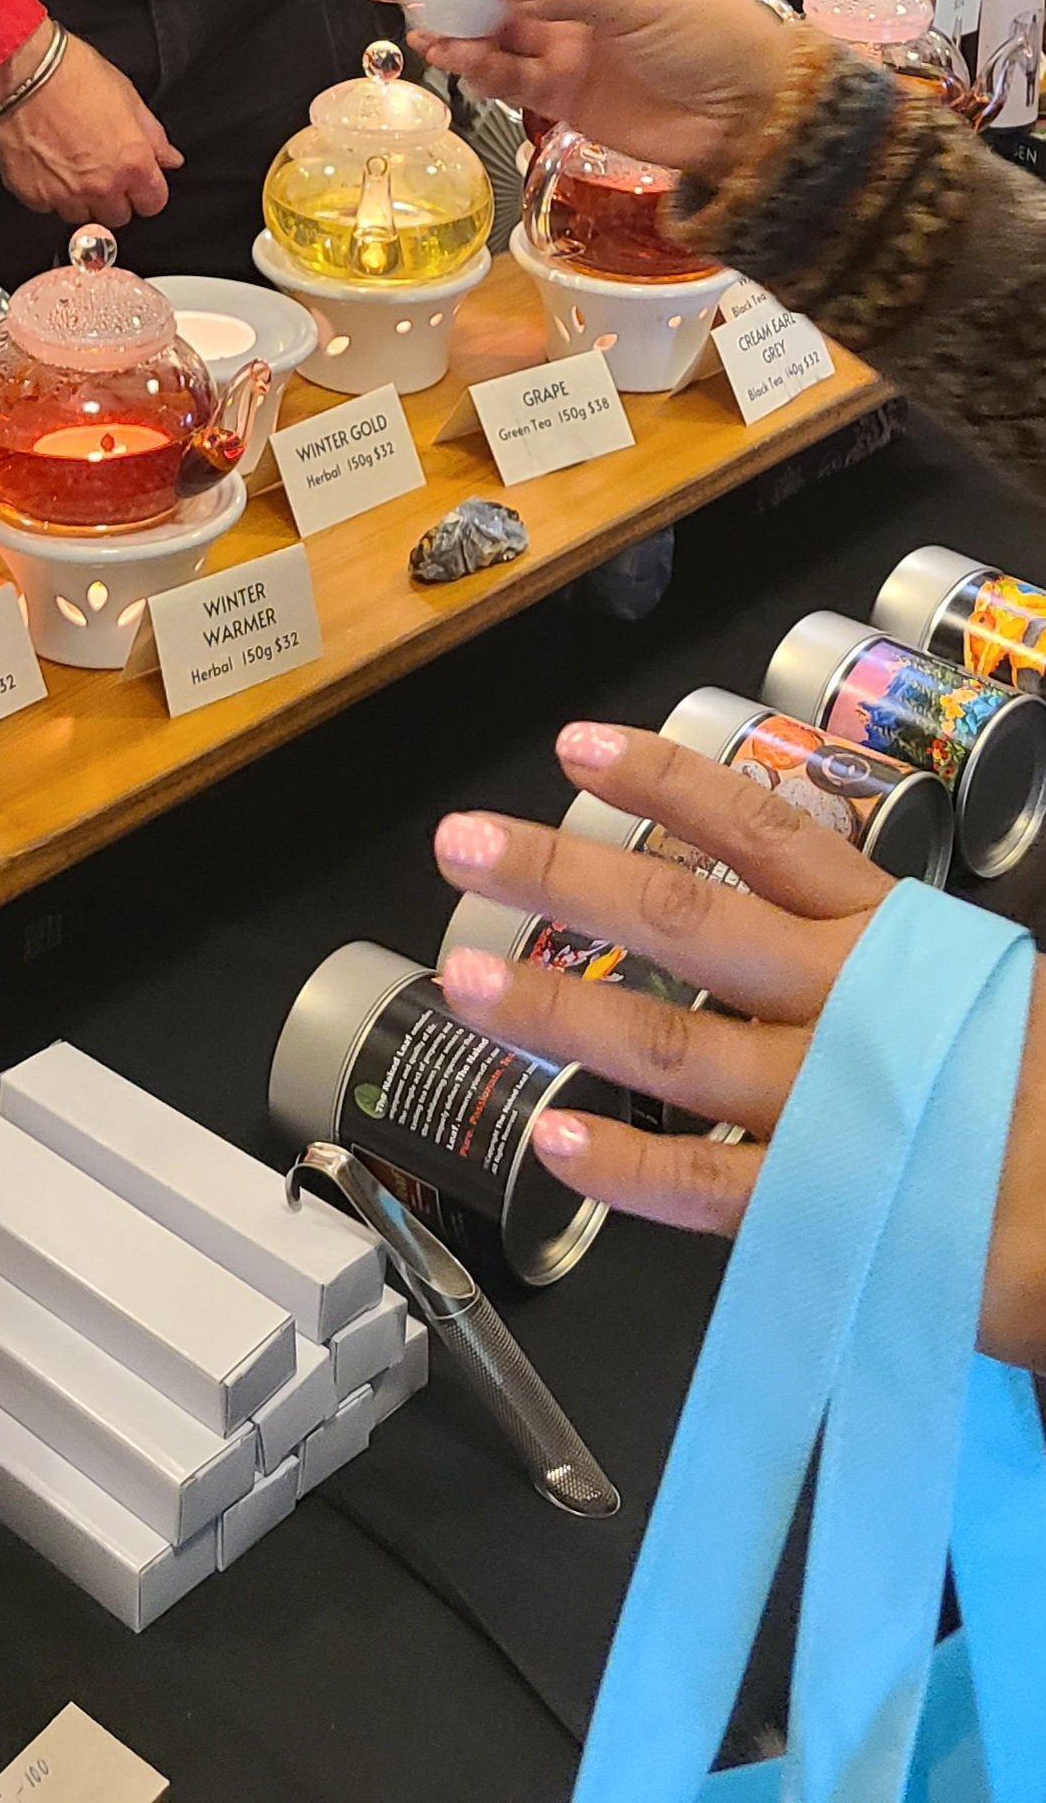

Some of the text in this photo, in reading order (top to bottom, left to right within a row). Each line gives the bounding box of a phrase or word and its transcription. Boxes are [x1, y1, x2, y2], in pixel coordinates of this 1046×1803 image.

[752, 292, 767, 307] Tea
[738, 311, 796, 351] CREAM EARL
[762, 340, 786, 364] GREY
[522, 381, 569, 407] GRAPE
[747, 383, 768, 401] Black
[768, 375, 783, 390] Tea
[804, 351, 820, 369] $32
[295, 414, 387, 463] WINTER GOLD
[498, 397, 610, 441] Green Tea 150g $38
[306, 441, 395, 489] Herbal 150g $32
[203, 582, 266, 618] WINTER
[203, 607, 277, 648] WARMER
[191, 632, 299, 685] Herbal 150g $32
[375, 1093, 387, 1112] The
[383, 1057, 400, 1091] Naked
[397, 1034, 412, 1057] Leaf
[455, 1065, 470, 1082] The
[466, 1038, 489, 1064] Naked
[496, 1114, 506, 1129] The
[503, 1089, 518, 1113] Naked
